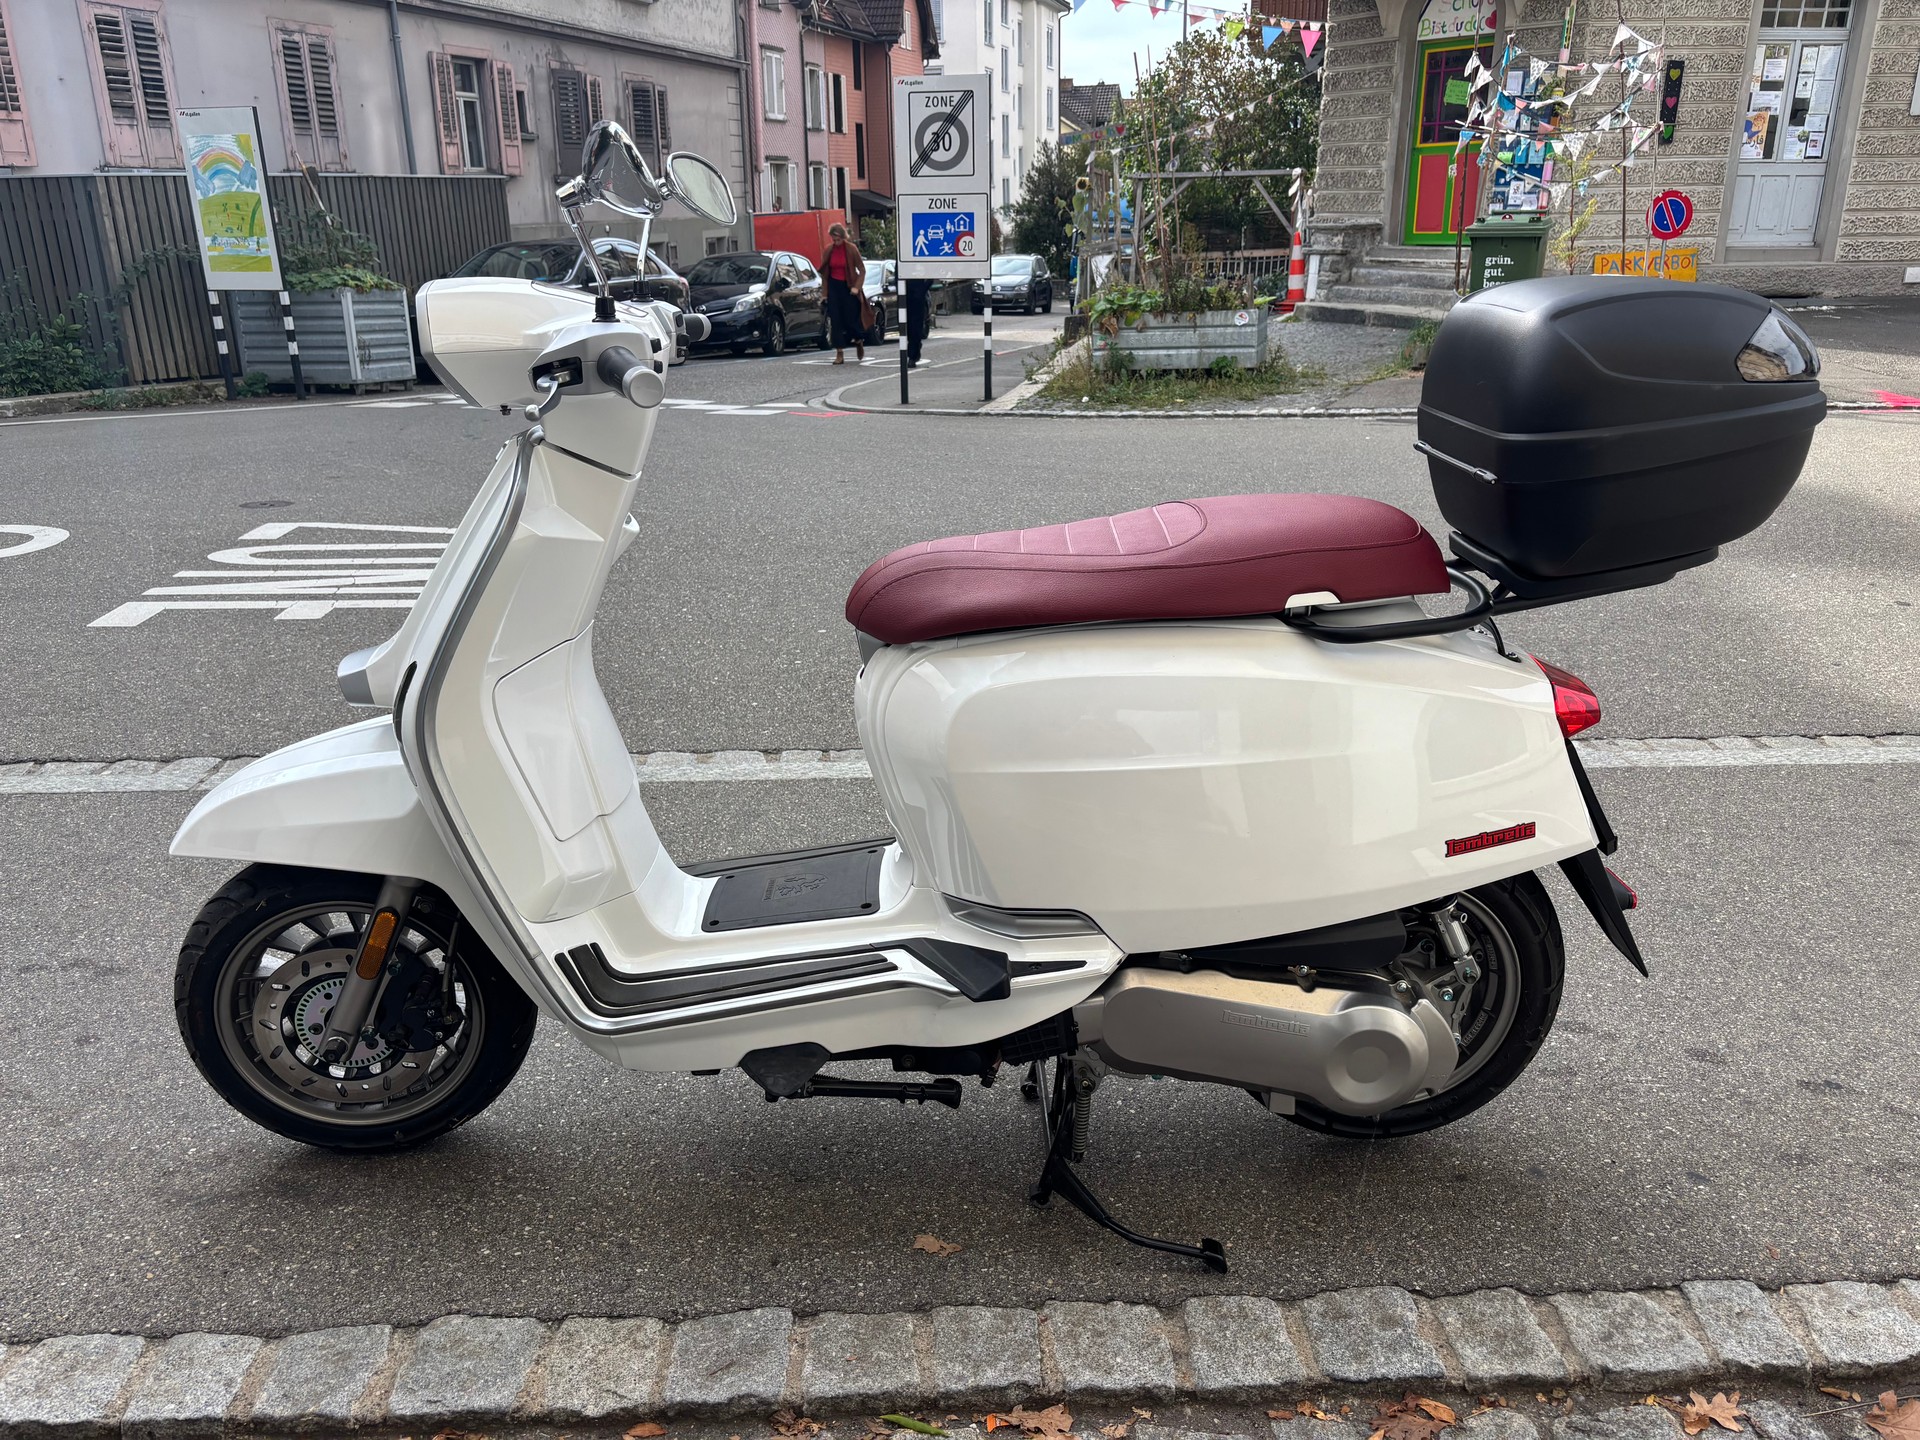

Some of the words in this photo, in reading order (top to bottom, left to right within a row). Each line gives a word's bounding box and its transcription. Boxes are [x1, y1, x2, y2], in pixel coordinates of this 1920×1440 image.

[925, 96, 955, 108] ZONE
[931, 131, 952, 152] 30
[928, 198, 957, 210] ZONE
[962, 240, 973, 252] 20
[1485, 254, 1514, 267] grün.
[1483, 267, 1505, 279] gut.
